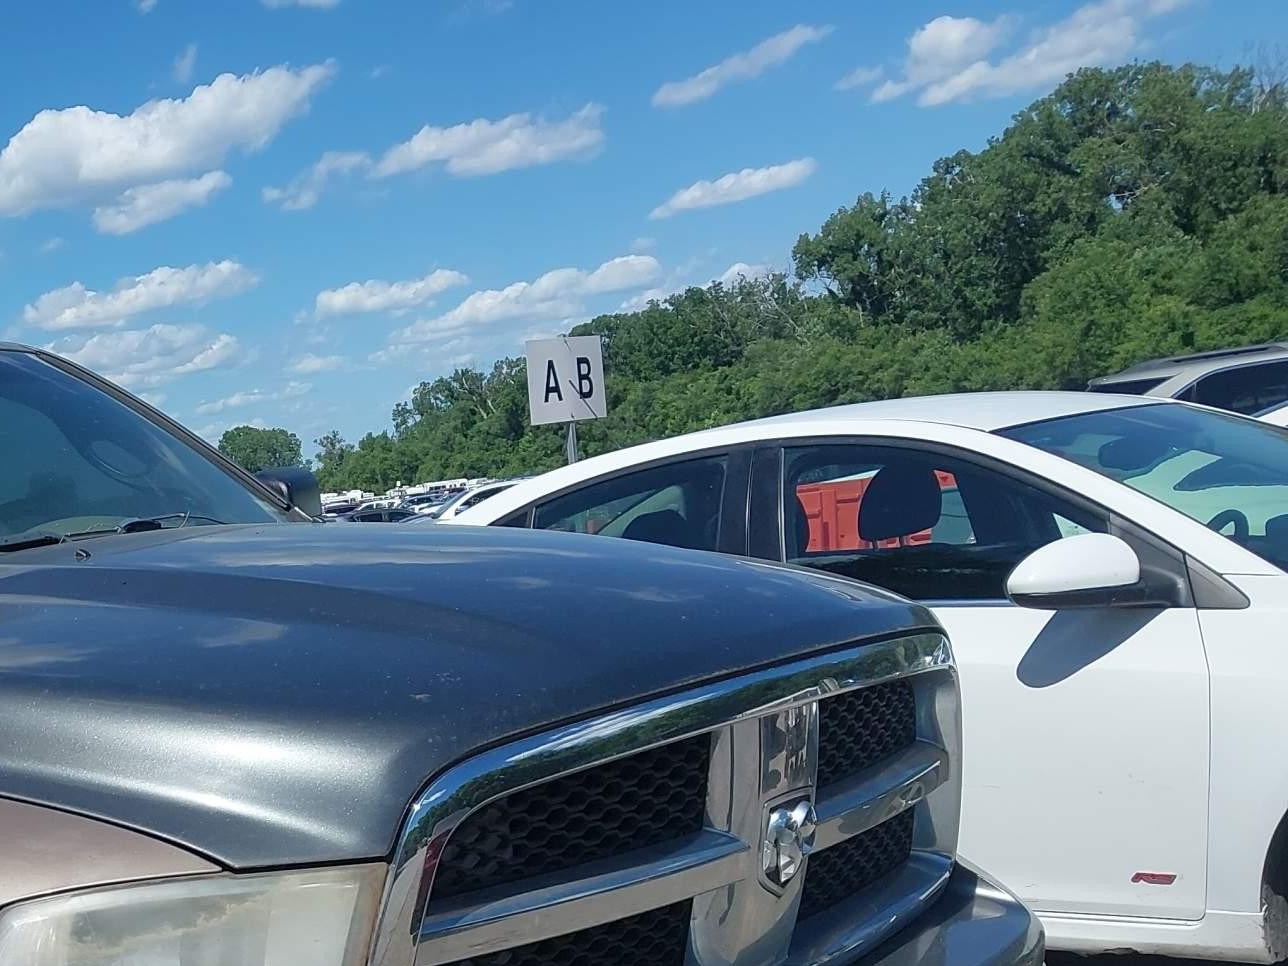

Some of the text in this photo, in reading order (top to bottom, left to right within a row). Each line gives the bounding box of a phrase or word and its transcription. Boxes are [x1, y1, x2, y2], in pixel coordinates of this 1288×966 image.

[544, 356, 594, 403] A B
[1130, 872, 1178, 886] RS
